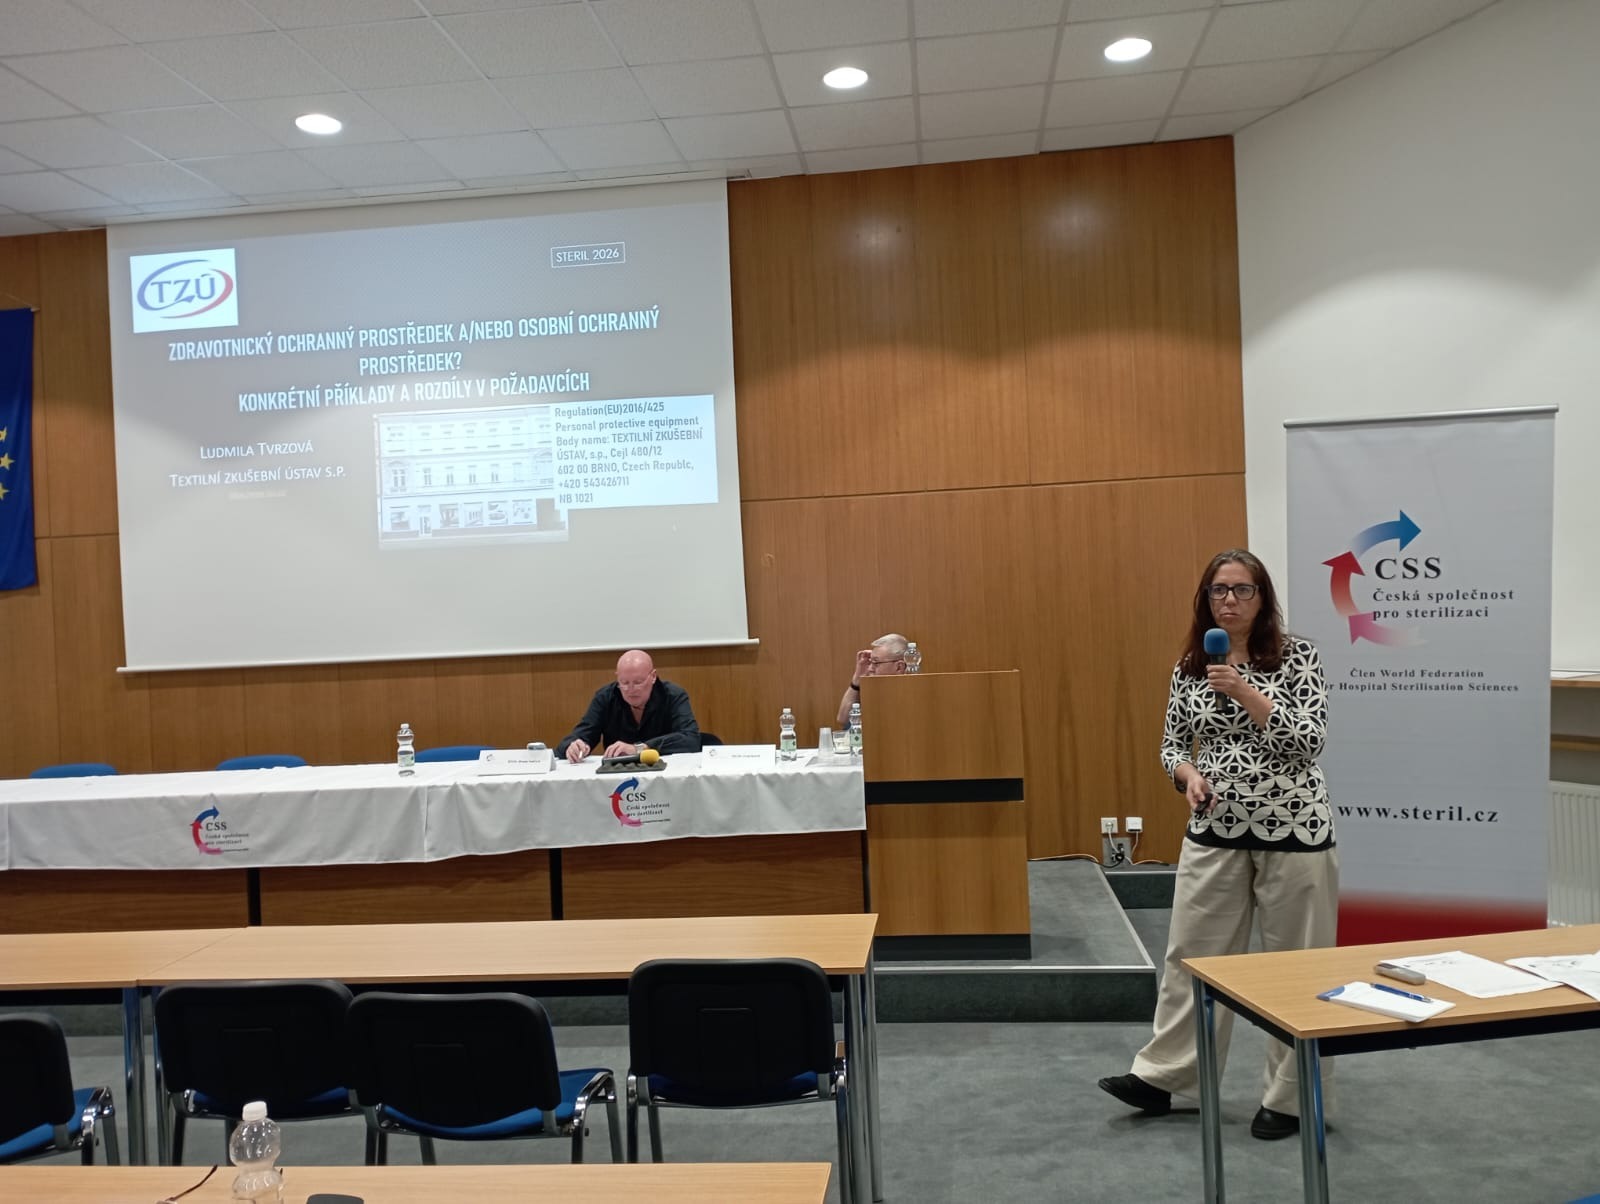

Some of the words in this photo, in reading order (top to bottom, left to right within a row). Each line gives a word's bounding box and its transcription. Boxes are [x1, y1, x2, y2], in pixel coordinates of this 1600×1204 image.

[555, 251, 589, 263] STERIL
[592, 247, 620, 260] 2026
[151, 273, 216, 304] TZÚ
[168, 331, 274, 361] ZDRAVOTNICKÝ
[277, 326, 355, 353] OCHRANNÝ
[359, 322, 455, 347] PROSTŘEDEK
[458, 319, 514, 344] A/NEBO
[518, 311, 574, 337] OSOBNÍ
[578, 305, 660, 333] OCHRANNÝ
[359, 350, 462, 376] PROSTŘEDEK?
[238, 385, 321, 412] KONKRÉTNÍ
[324, 382, 396, 406] PŘÍKLADY
[400, 386, 409, 402] A
[415, 376, 473, 399] ROZDÍLY
[476, 380, 486, 396] V
[490, 369, 590, 396] POŽADAVCÍCH
[554, 402, 665, 419] Regulation(EU)2016/425
[555, 422, 596, 432] Personal
[599, 418, 646, 430] protective
[648, 416, 699, 429] equipment
[556, 436, 579, 448] Body
[581, 436, 610, 445] name:
[611, 429, 653, 443] TEXTILNÍ
[655, 427, 703, 441] ZKUŠEBNÍ
[556, 449, 588, 461] ÚSTAV,
[610, 448, 628, 459] Cejl
[631, 446, 662, 457] 480/12
[557, 465, 574, 474] 602
[577, 464, 588, 473] 00
[591, 462, 620, 473] BRNO,
[622, 461, 650, 471] Czech
[559, 479, 581, 488] +420
[559, 494, 572, 504] NB
[575, 493, 593, 502] 1021
[1375, 557, 1441, 579] CSS
[1373, 588, 1420, 602] Česká
[1427, 589, 1514, 603] společnost
[1373, 610, 1399, 621] pro
[1406, 606, 1489, 618] sterilizaci
[1350, 668, 1376, 678] Člen
[1380, 669, 1415, 678] World
[1420, 669, 1484, 678] Federation
[1339, 683, 1387, 692] Hospital
[1391, 683, 1464, 691] Sterilisation
[1468, 683, 1519, 692] Sciences
[626, 792, 647, 802] CSS
[1338, 806, 1498, 822] www.steril.cz
[206, 821, 227, 832] CSS
